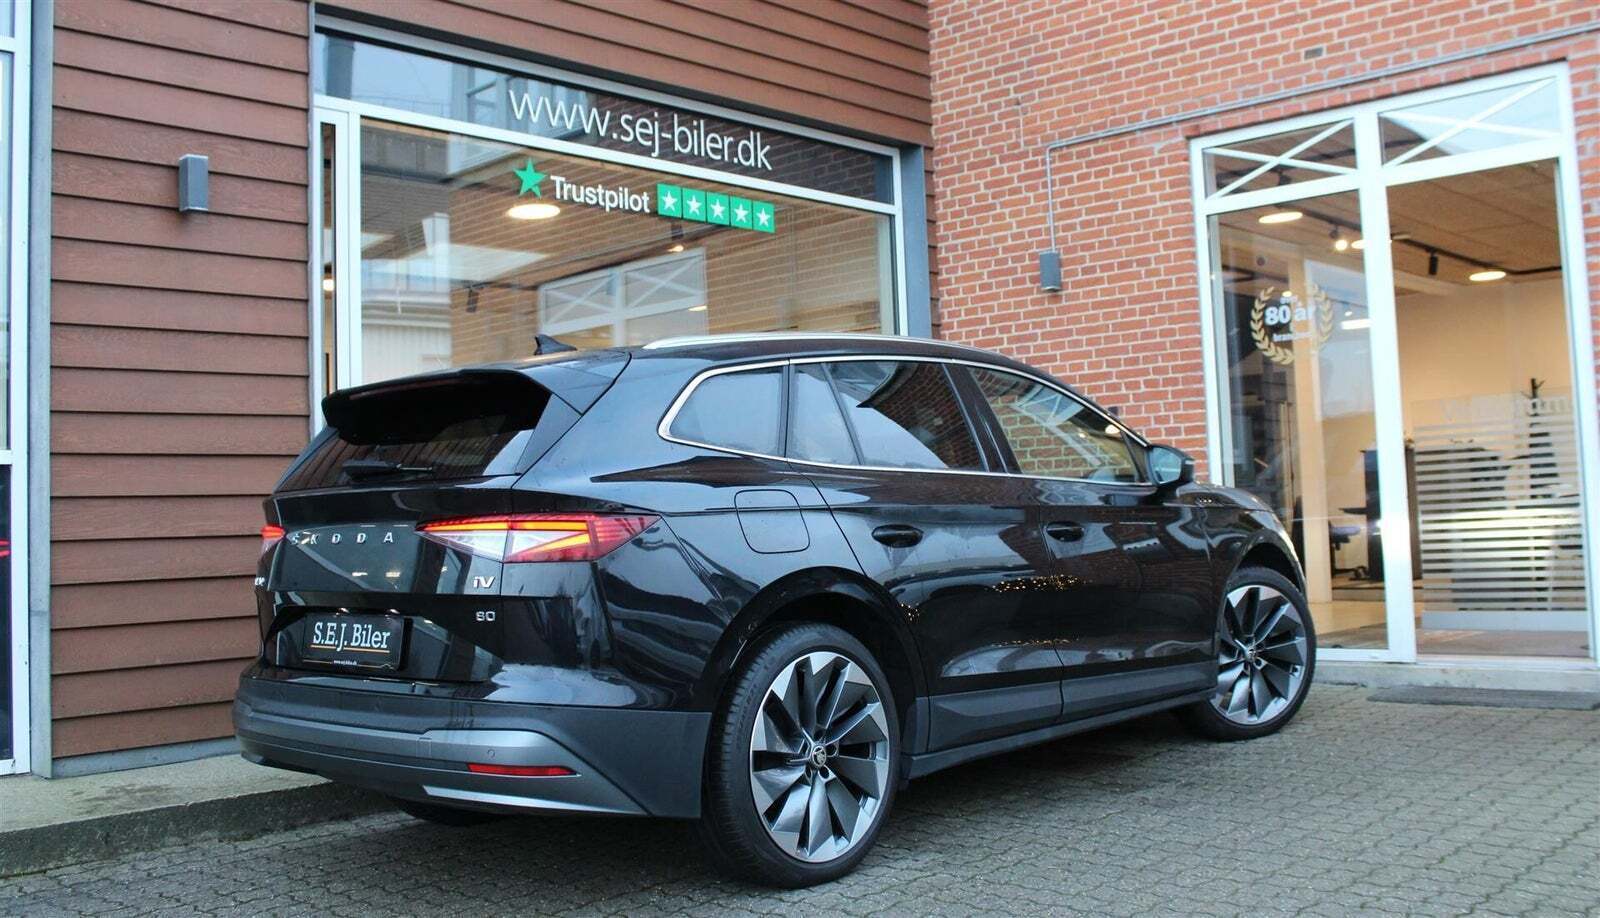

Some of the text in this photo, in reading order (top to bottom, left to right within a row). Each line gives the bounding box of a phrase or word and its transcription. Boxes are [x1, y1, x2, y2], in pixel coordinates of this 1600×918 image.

[508, 89, 773, 171] www.sej-biler.dk
[550, 175, 650, 213] Trustpilot
[1265, 304, 1290, 325] 80
[312, 621, 391, 652] S.E.J. Biler
